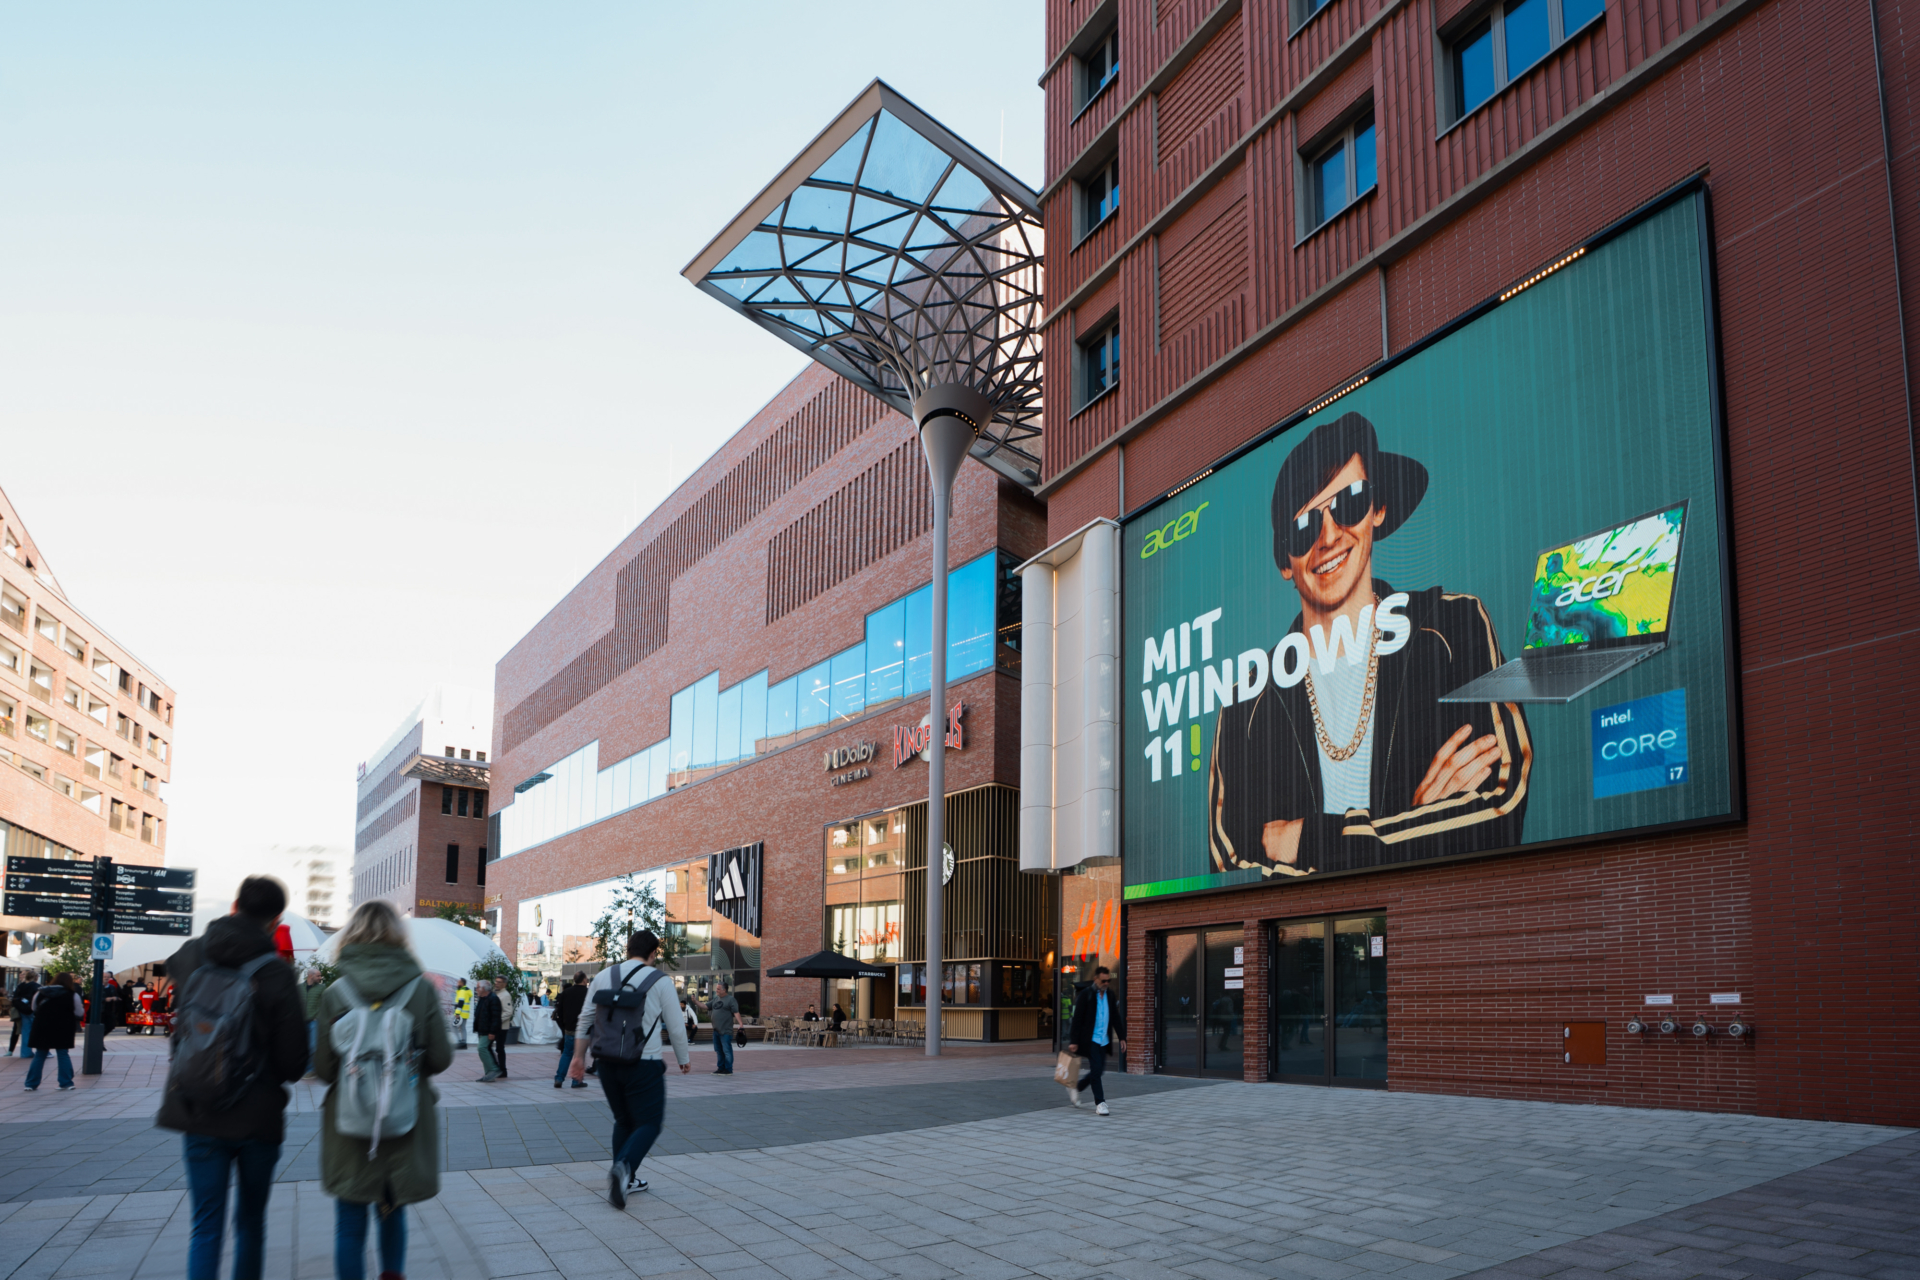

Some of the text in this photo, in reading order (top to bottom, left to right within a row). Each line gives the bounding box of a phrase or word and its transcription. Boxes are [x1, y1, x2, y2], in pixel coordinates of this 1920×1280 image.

[1140, 500, 1210, 559] acer
[1555, 564, 1639, 607] acer
[1141, 592, 1411, 733] WINDOWS
[1142, 606, 1222, 684] MIT
[840, 740, 877, 768] Dolby
[893, 700, 963, 770] KINOPIS
[1143, 723, 1201, 783] 11!
[831, 767, 870, 787] CINEMA
[1669, 766, 1684, 782] i7
[472, 902, 484, 911] ST
[1071, 898, 1121, 962] H&M
